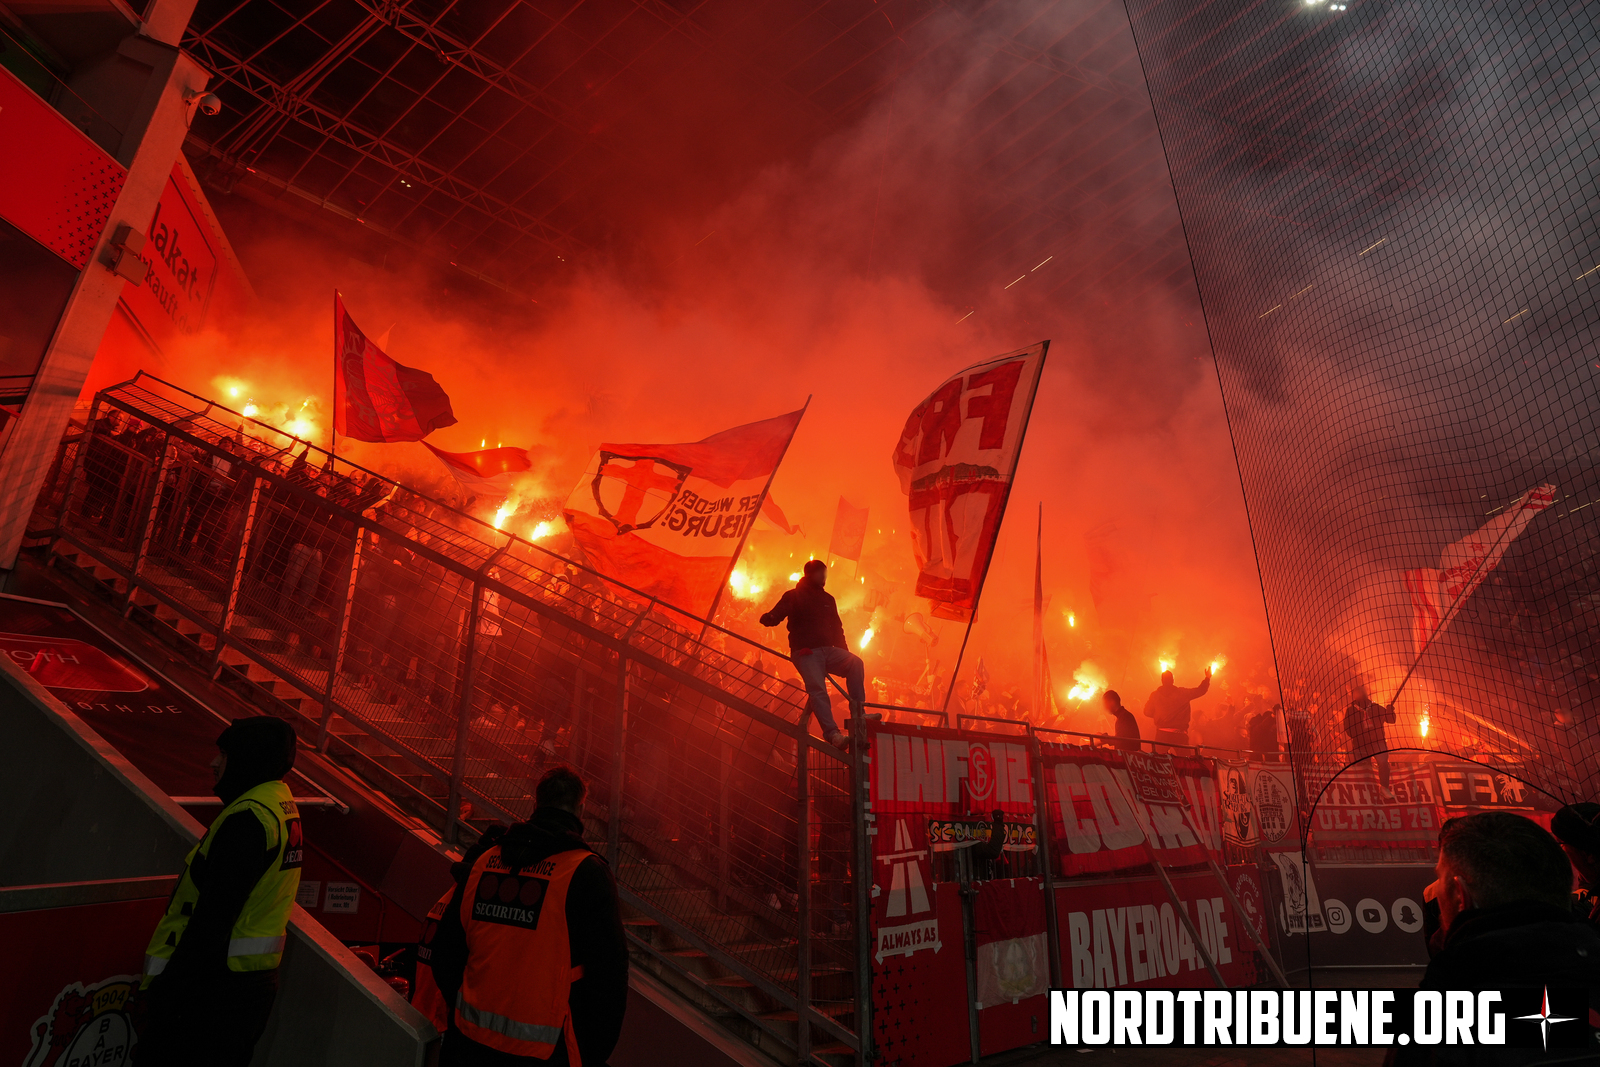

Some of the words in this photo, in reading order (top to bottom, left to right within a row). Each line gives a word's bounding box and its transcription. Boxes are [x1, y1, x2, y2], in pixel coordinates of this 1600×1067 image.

[876, 732, 970, 803] IWF
[988, 742, 1031, 804] 12
[1316, 808, 1402, 830] ULTRAS
[1407, 807, 1433, 829] 79
[474, 902, 535, 924] SECURITAS
[881, 928, 922, 952] ALWAYS
[924, 927, 936, 943] A5
[95, 989, 125, 1010] 1904
